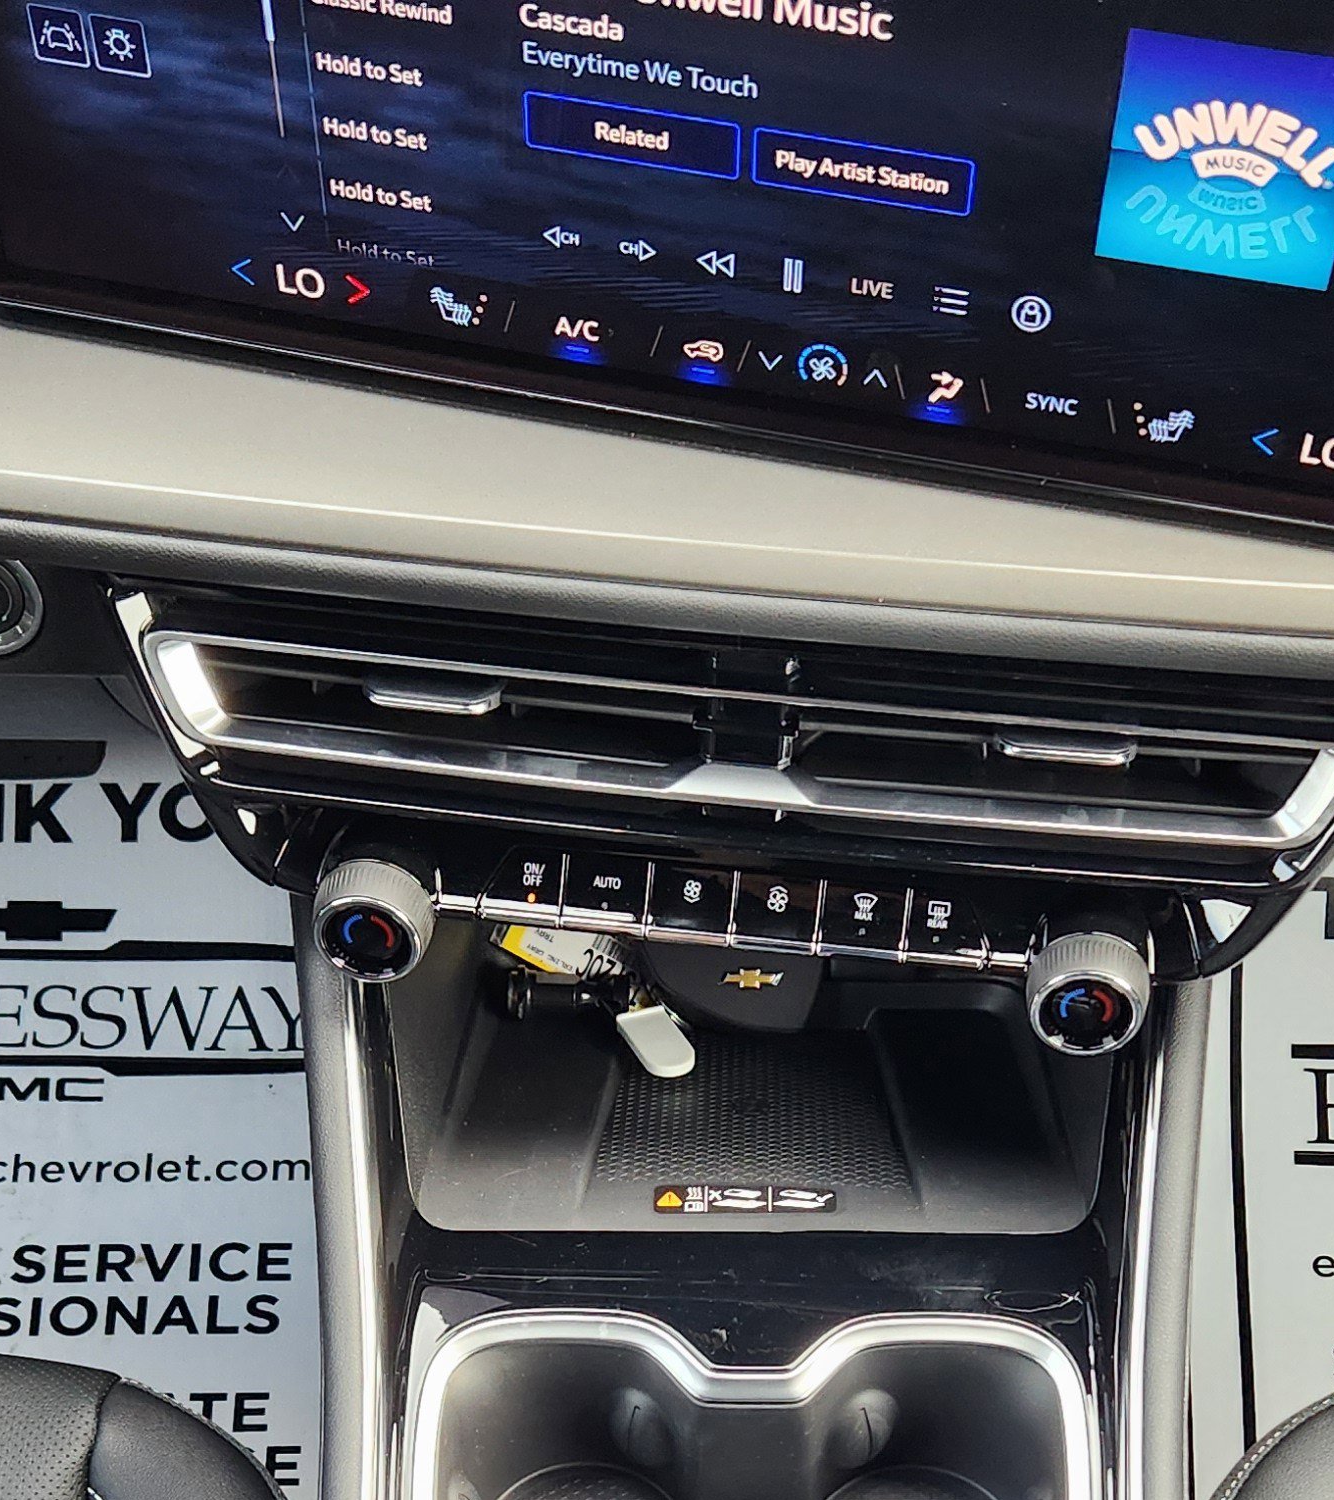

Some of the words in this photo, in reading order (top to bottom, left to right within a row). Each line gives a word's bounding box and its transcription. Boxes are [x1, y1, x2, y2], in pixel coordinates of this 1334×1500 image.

[379, 0, 453, 25] Rewind
[519, 3, 625, 42] Cascada
[634, 0, 763, 20] well
[772, 0, 895, 41] Music
[316, 52, 361, 77] Hold
[365, 61, 387, 81] to
[389, 63, 423, 87] Set
[522, 40, 640, 83] Everytime
[644, 60, 683, 87] We
[686, 66, 759, 100] Touch
[322, 116, 368, 142] Hold
[370, 125, 392, 145] to
[394, 128, 428, 151] Set
[594, 120, 670, 152] Related
[774, 149, 817, 179] Play
[819, 157, 877, 185] Artist
[878, 165, 950, 196] Station
[1204, 155, 1268, 179] MUSIC
[329, 178, 373, 203] Hold
[376, 188, 397, 207] to
[399, 191, 433, 213] Set
[337, 238, 378, 260] Hold
[560, 231, 580, 246] CH
[619, 241, 638, 255] CH
[275, 263, 326, 300] LO
[850, 277, 895, 300] LIVE
[554, 316, 601, 342] A/C
[1025, 392, 1079, 417] SYNC
[100, 782, 216, 843] YO
[522, 874, 543, 888] OFF
[524, 861, 546, 876] ON/
[593, 875, 622, 890] AUTO
[854, 911, 874, 922] MAX
[927, 918, 949, 930] REAR
[10, 1242, 294, 1285] SERVICE
